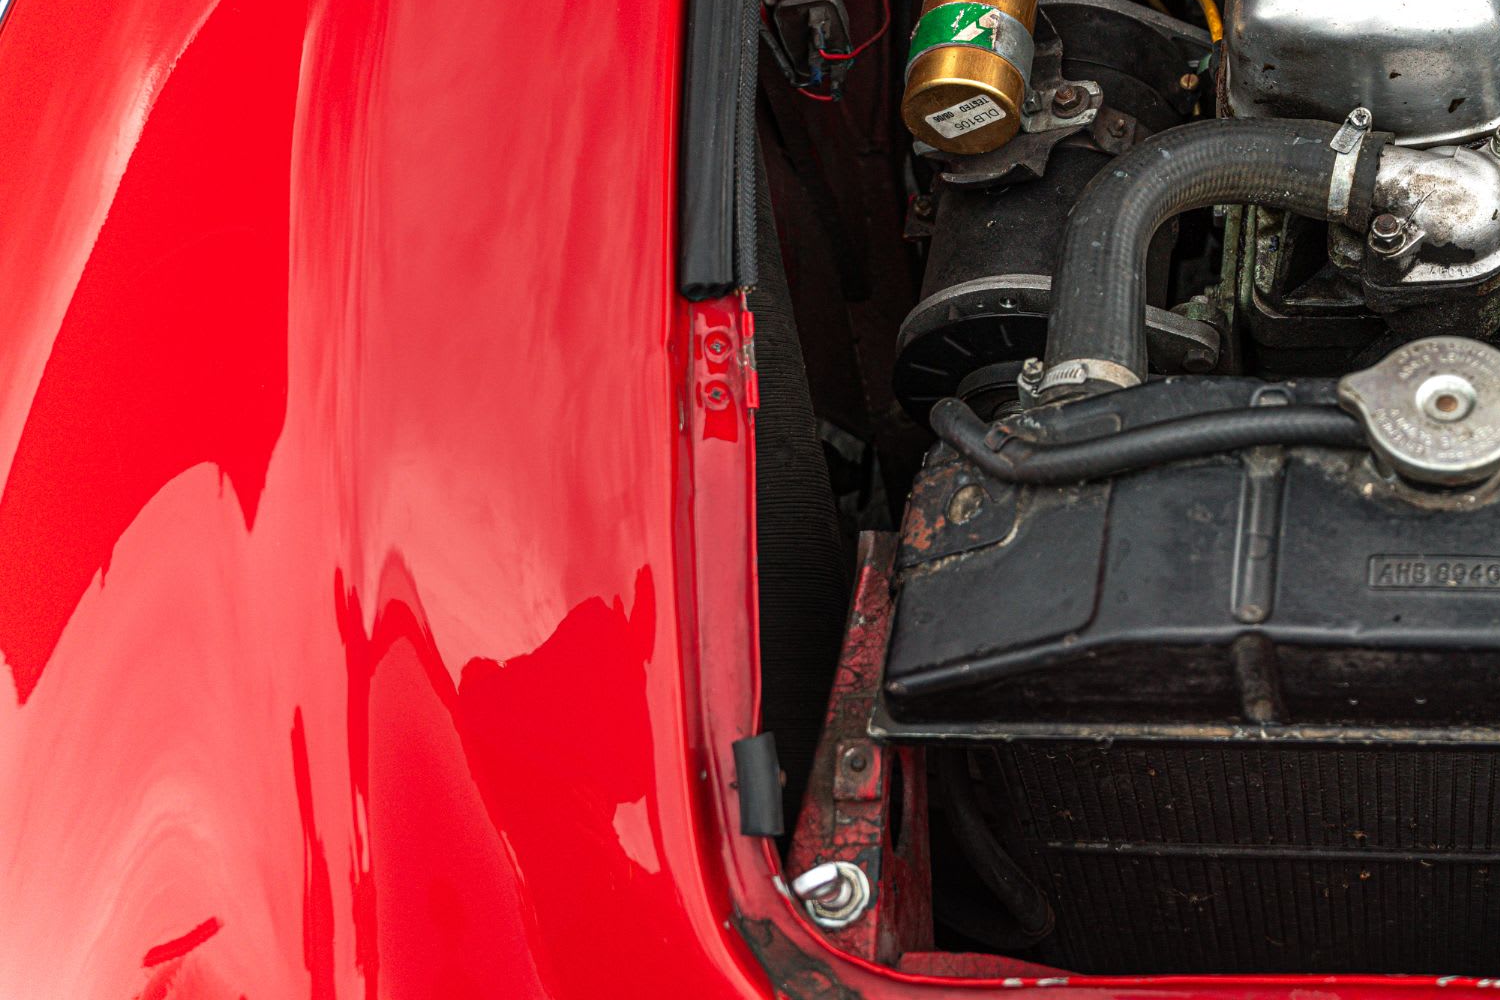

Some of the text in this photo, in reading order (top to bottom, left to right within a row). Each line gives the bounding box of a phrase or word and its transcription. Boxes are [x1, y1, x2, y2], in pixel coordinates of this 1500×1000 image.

[959, 97, 989, 112] TESTED
[955, 108, 1000, 130] DLB105
[1379, 562, 1427, 585] AHB
